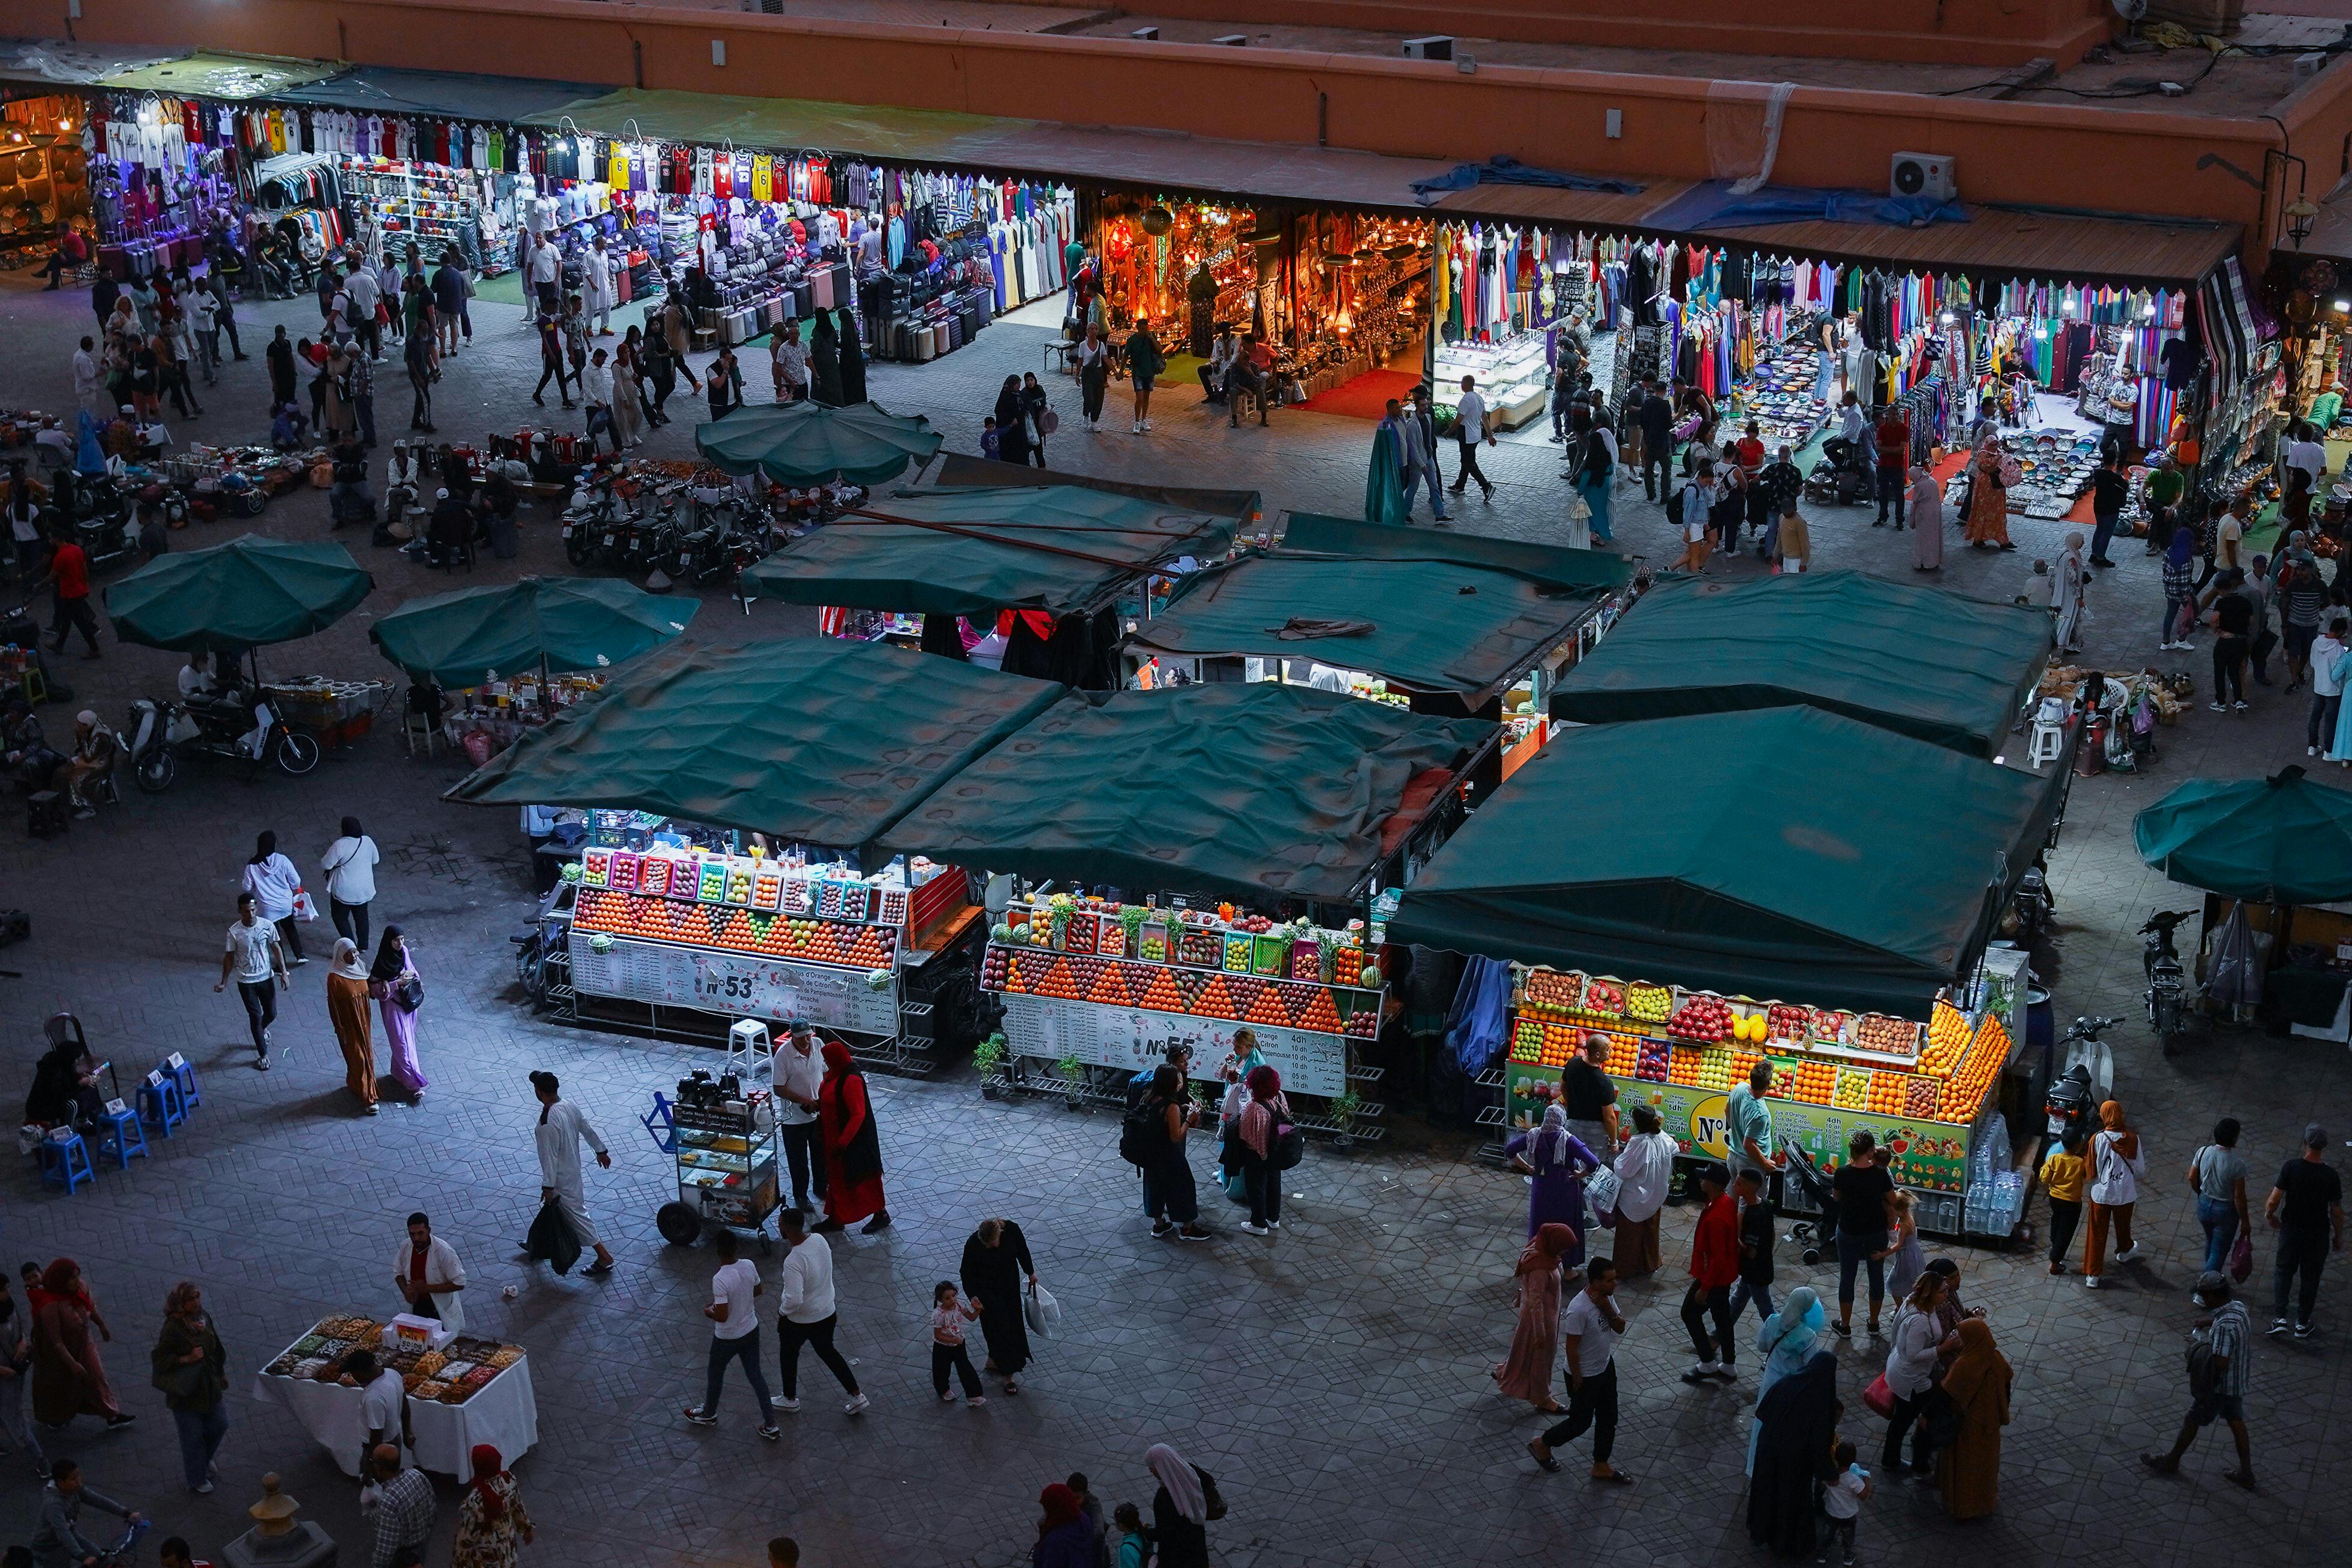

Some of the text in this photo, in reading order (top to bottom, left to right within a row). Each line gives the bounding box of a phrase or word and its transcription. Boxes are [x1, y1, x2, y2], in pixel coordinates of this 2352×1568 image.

[192, 117, 198, 130] 2
[275, 126, 280, 136] 6
[617, 161, 622, 172] 6
[702, 167, 708, 178] 6
[761, 174, 767, 185] 6
[806, 972, 831, 981] d'Orange
[843, 975, 858, 984] 4dh
[1254, 1031, 1306, 1044] 'Orange 4dh
[1260, 1040, 1278, 1049] Citron
